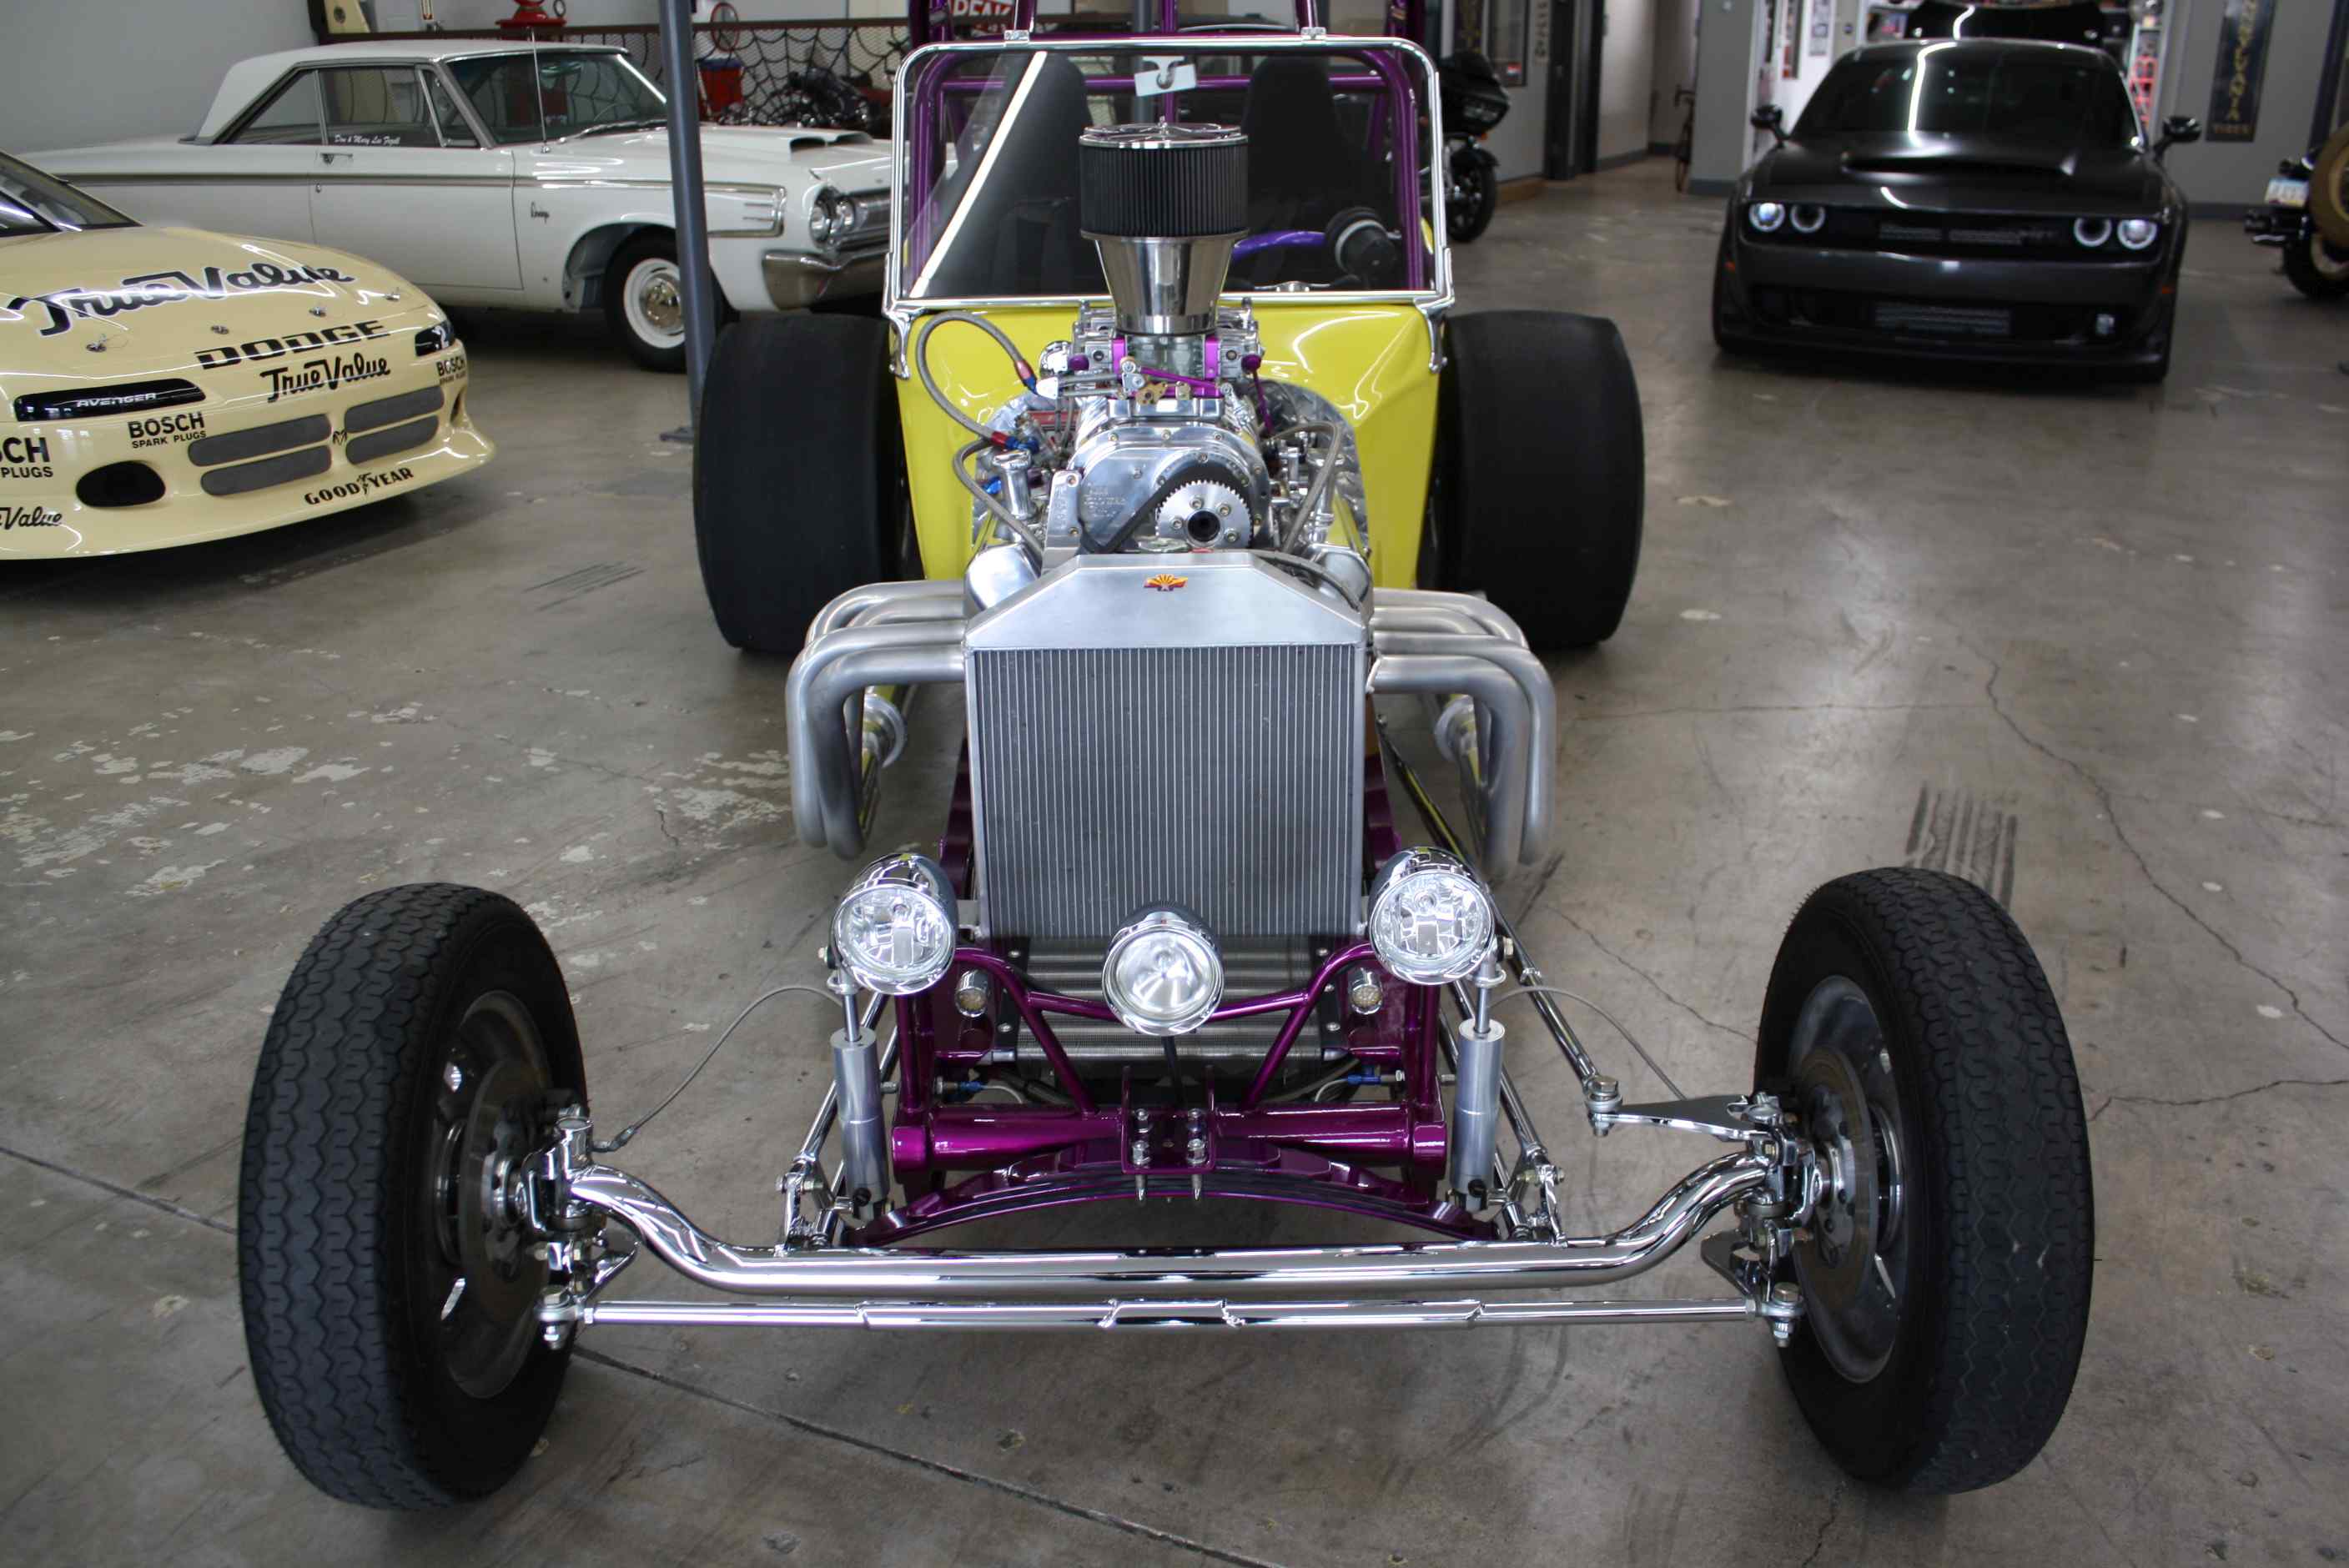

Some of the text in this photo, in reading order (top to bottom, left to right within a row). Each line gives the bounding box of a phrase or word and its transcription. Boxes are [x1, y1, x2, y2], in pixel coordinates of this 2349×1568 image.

[194, 320, 390, 369] DODGE
[77, 393, 157, 408] AVENGER
[128, 411, 205, 439] BOSCH
[132, 430, 207, 449] SPARK PLUGS
[1, 466, 53, 479] PLUGS
